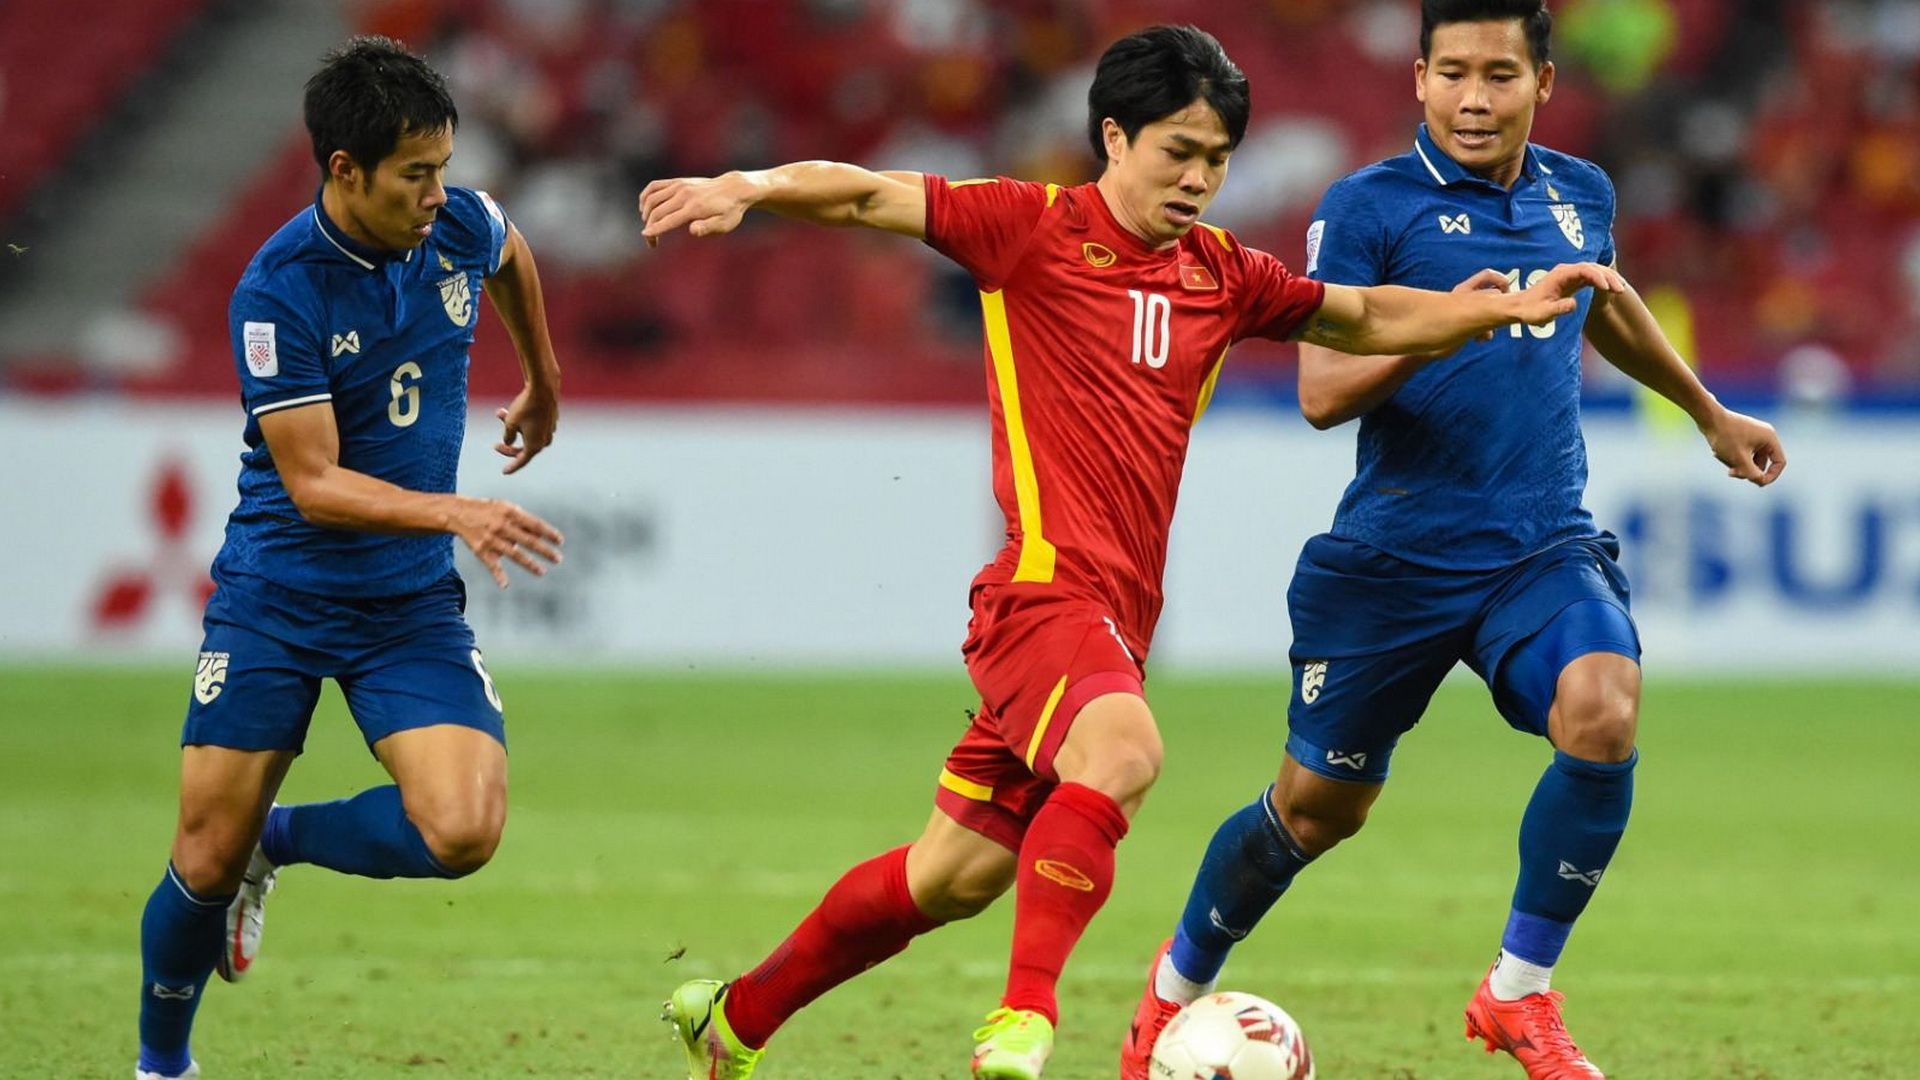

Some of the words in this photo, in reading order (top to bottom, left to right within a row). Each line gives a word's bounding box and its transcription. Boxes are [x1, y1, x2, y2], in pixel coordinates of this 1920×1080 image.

[1128, 289, 1171, 369] 10
[388, 361, 422, 428] 6
[1688, 496, 1919, 606] SU
